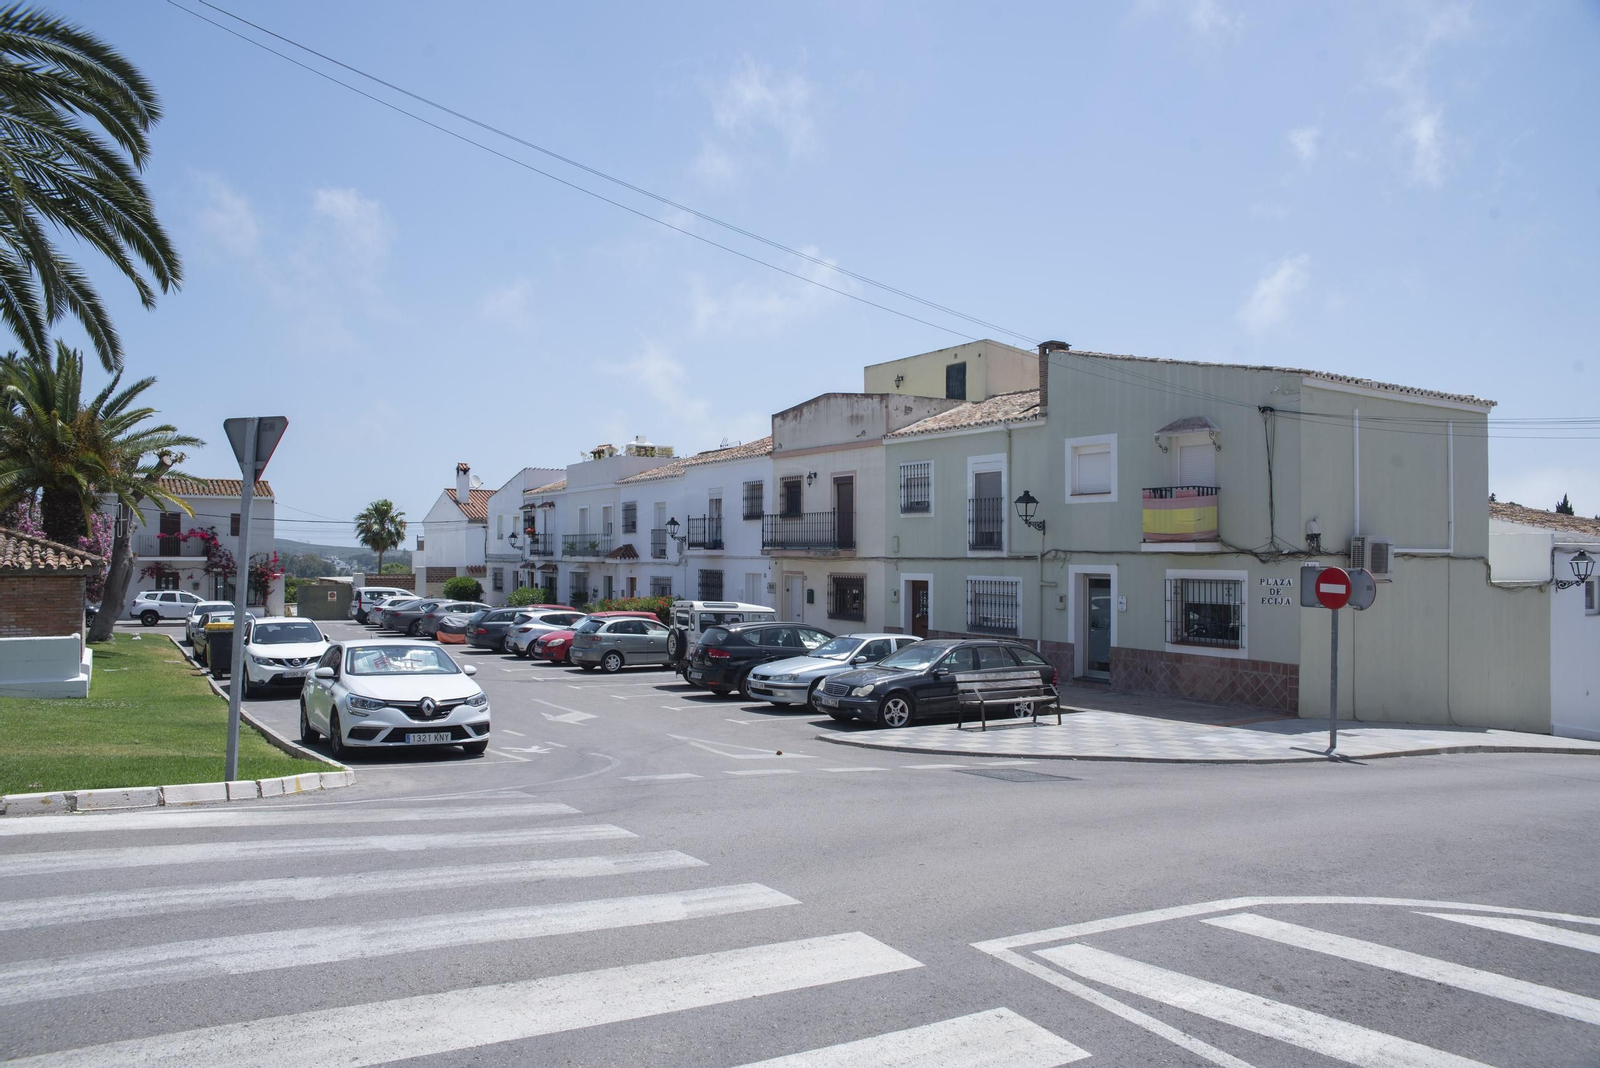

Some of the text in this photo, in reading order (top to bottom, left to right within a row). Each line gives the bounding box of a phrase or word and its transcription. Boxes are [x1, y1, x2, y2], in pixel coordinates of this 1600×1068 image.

[1260, 578, 1292, 587] PLAZA
[1269, 588, 1282, 596] DE
[1261, 597, 1291, 605] ECIJA
[412, 733, 450, 742] 1321 KNY
